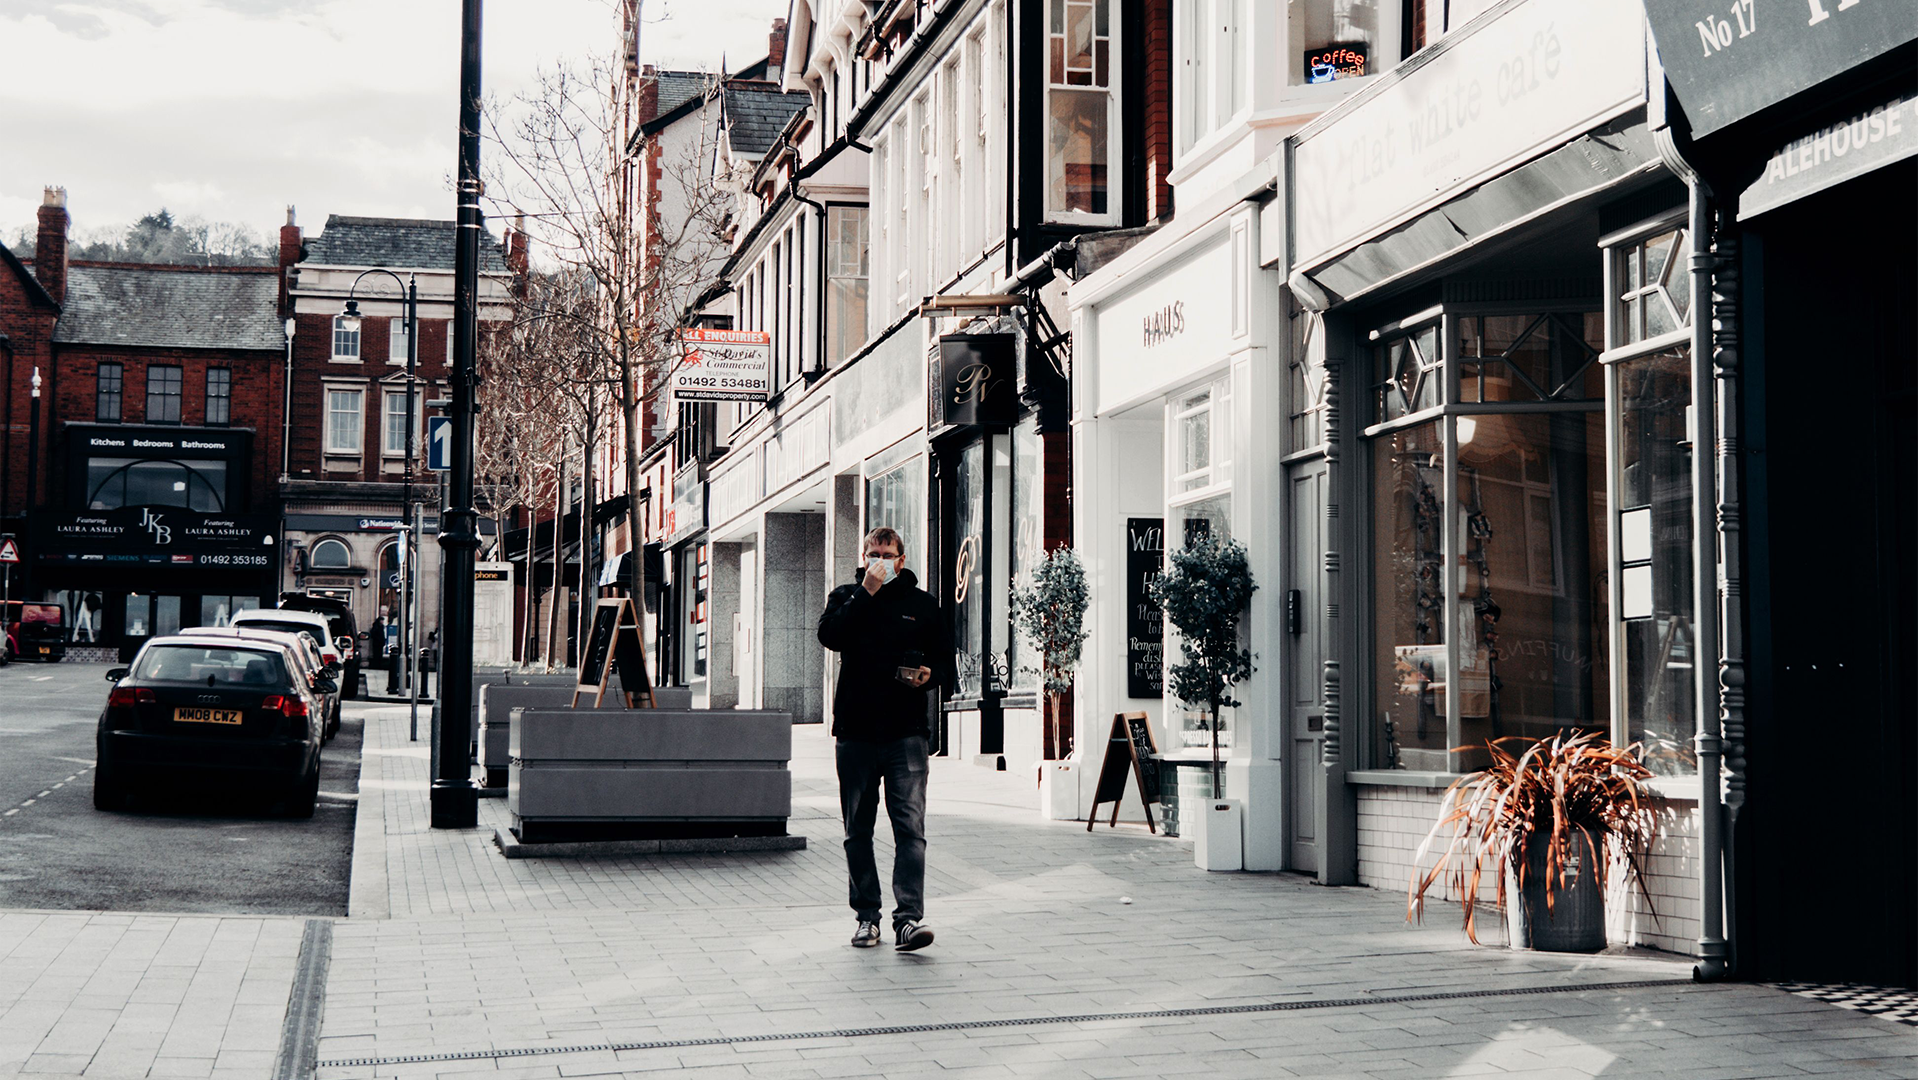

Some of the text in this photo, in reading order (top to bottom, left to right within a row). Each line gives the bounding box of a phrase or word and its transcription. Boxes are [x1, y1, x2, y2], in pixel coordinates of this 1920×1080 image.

[1695, 15, 1733, 57] No
[1347, 22, 1562, 191] flat white café
[1767, 100, 1903, 185] ALEHOUSE
[704, 331, 764, 343] ENQUIRIES
[706, 359, 766, 370] Commercial
[679, 376, 766, 388] 01492 534881
[677, 391, 766, 400] www.stdavidsproperty.com
[90, 438, 226, 449] Kitchens Bedrooms Bathrooms
[76, 516, 107, 525] Featuring
[138, 507, 172, 545] JKB
[203, 519, 235, 528] Featuring
[57, 525, 125, 534] LAURA ASHLEY
[217, 528, 252, 536] ASHLEY
[200, 554, 230, 564] 01492
[232, 555, 268, 565] 353185
[213, 710, 238, 723] CWZ
